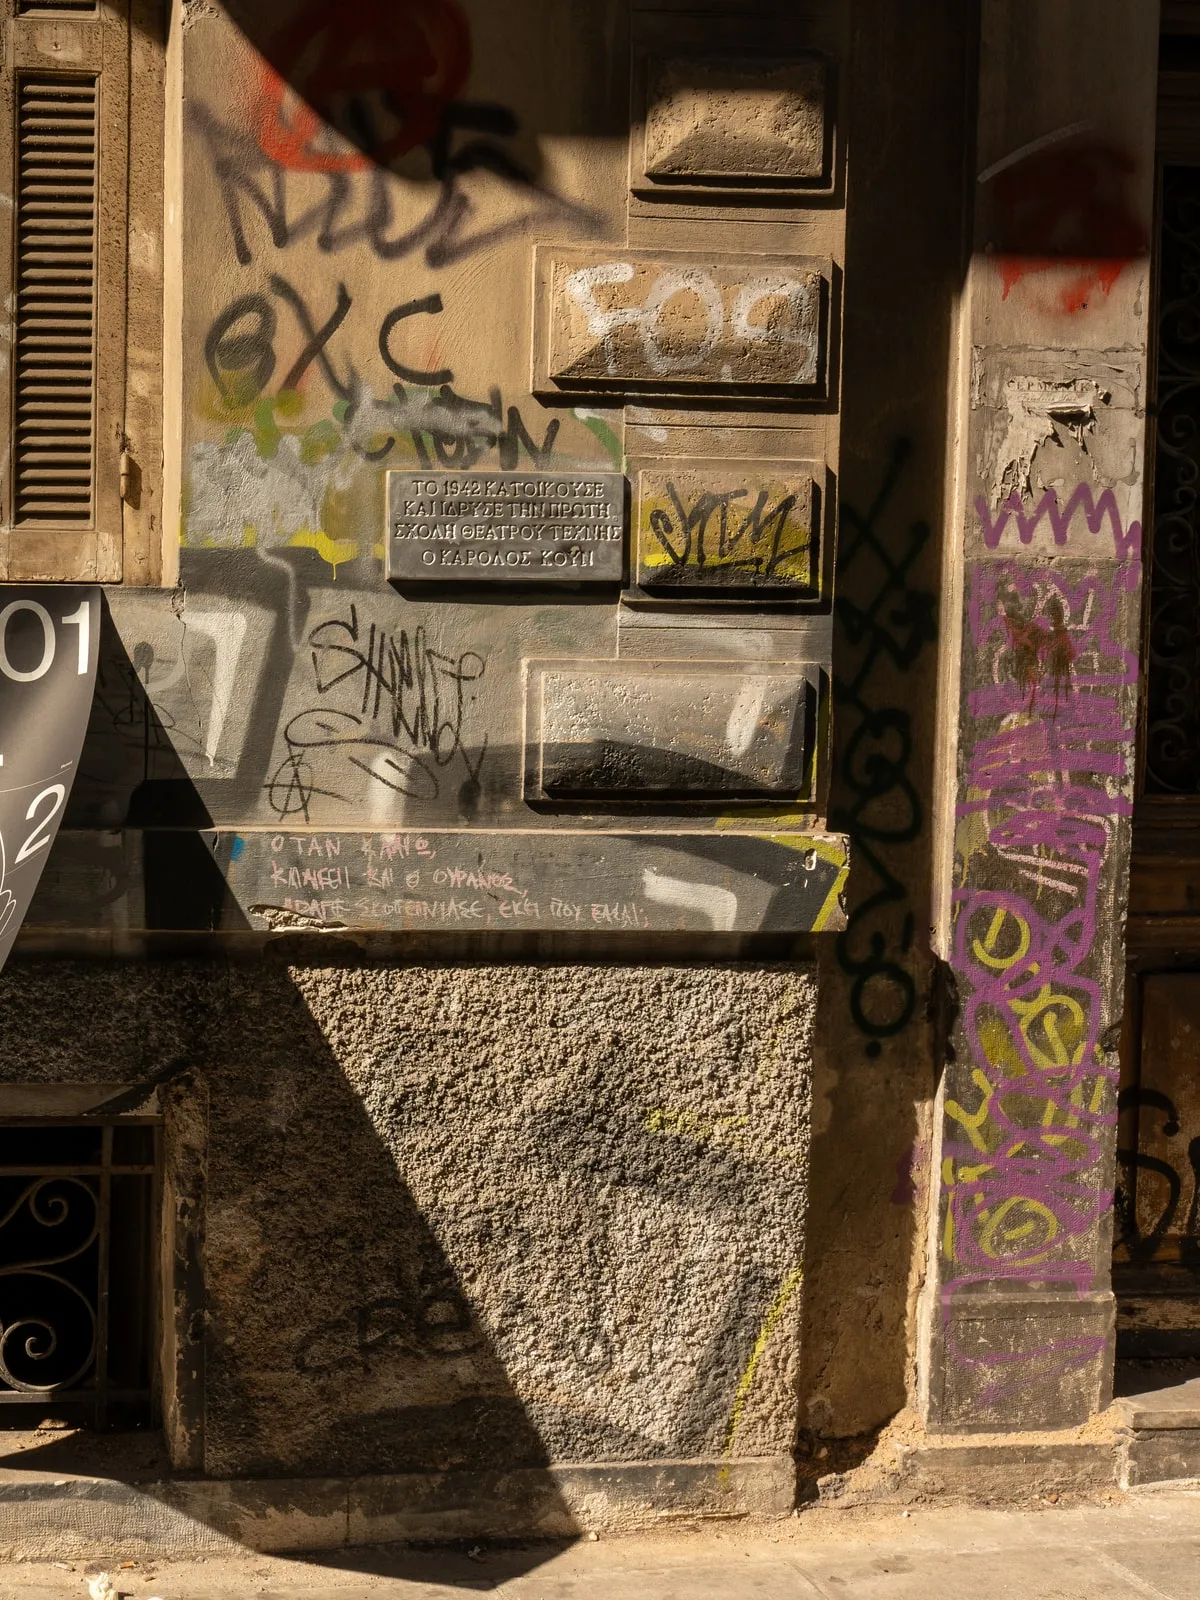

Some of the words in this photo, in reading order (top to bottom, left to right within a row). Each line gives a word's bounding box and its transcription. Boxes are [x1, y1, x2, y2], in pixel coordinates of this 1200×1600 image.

[412, 480, 439, 497] ΤΟ
[443, 480, 481, 497] 1942
[485, 481, 604, 498] ΚΑΤΟΙΚΟΥΣΕ
[403, 500, 437, 518] ΚΑΙ
[440, 501, 504, 518] ΙΔΡΥΣΕ
[508, 502, 545, 519] ΤΗΝ
[549, 502, 611, 520] ΠΡΩΤΗ
[394, 523, 457, 541] ΣΧΟΛΗ
[461, 524, 547, 541] ΘΕΑΤΡΟΥ
[549, 525, 623, 541] ΤΕΧΝΗΣ
[421, 550, 437, 566] Ο
[440, 550, 531, 567] ΚΑΡΟΛΟΣ
[541, 550, 594, 567] ΚΟΥΝ
